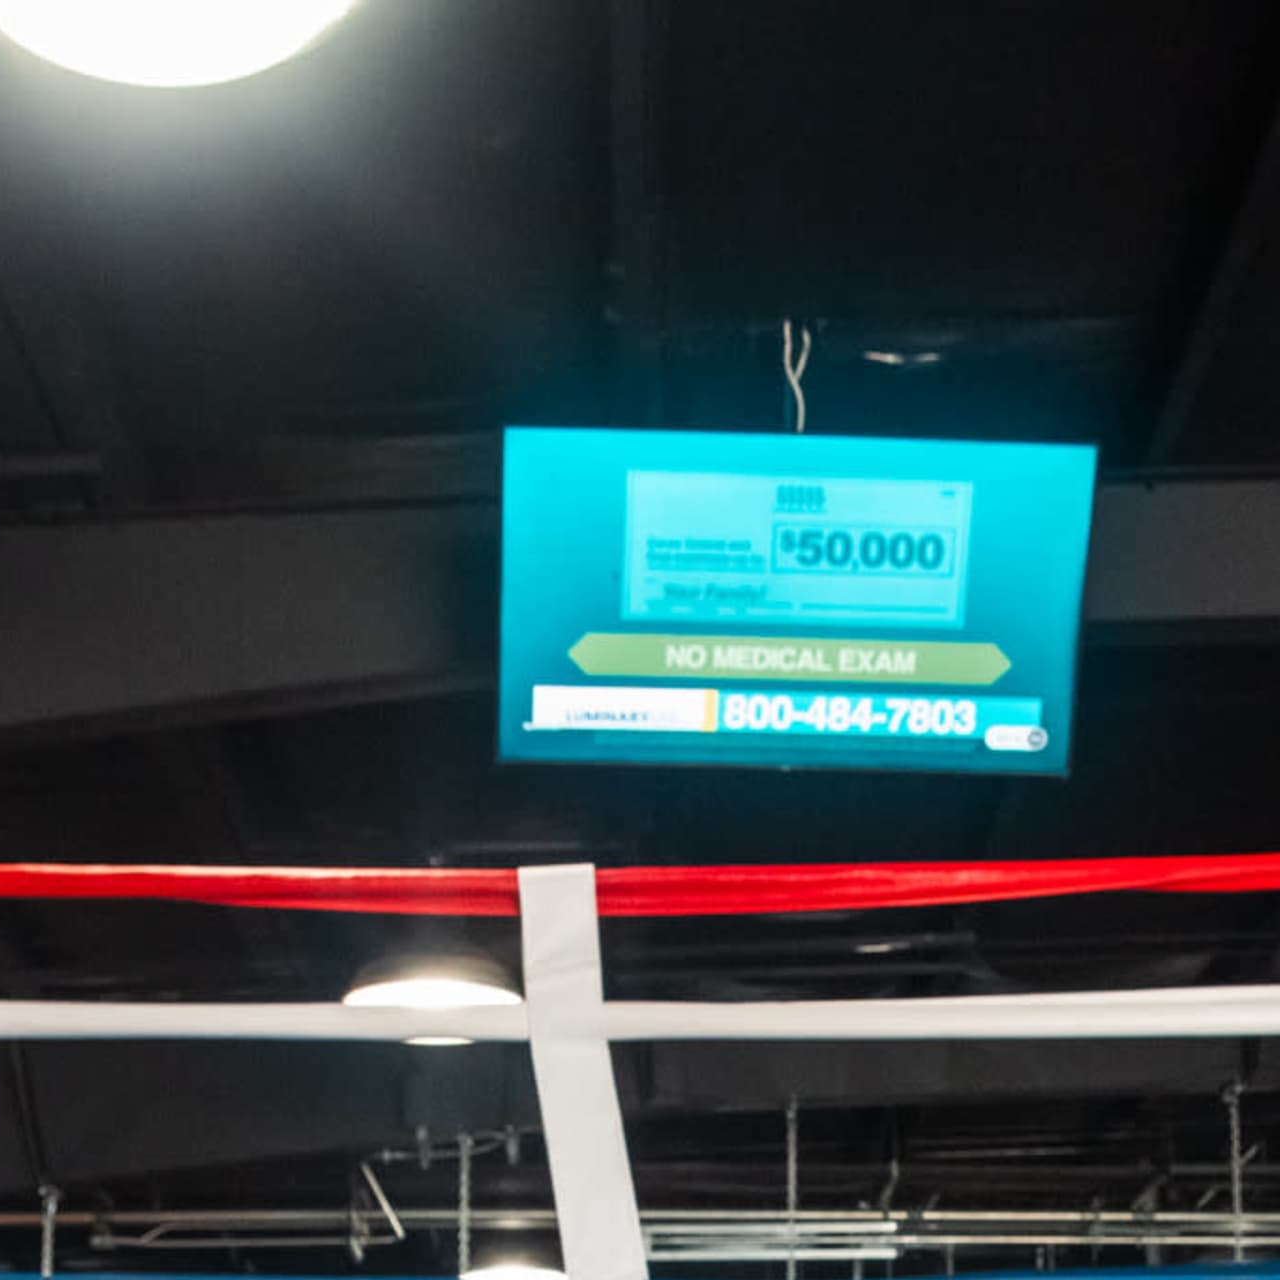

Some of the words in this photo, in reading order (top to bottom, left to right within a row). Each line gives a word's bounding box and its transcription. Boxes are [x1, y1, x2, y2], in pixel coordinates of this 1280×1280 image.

[779, 528, 946, 574] $50,000
[665, 644, 708, 669] NO
[714, 646, 832, 673] MEDICAL
[839, 648, 917, 675] EXAM
[723, 692, 977, 735] 800-484-7803
